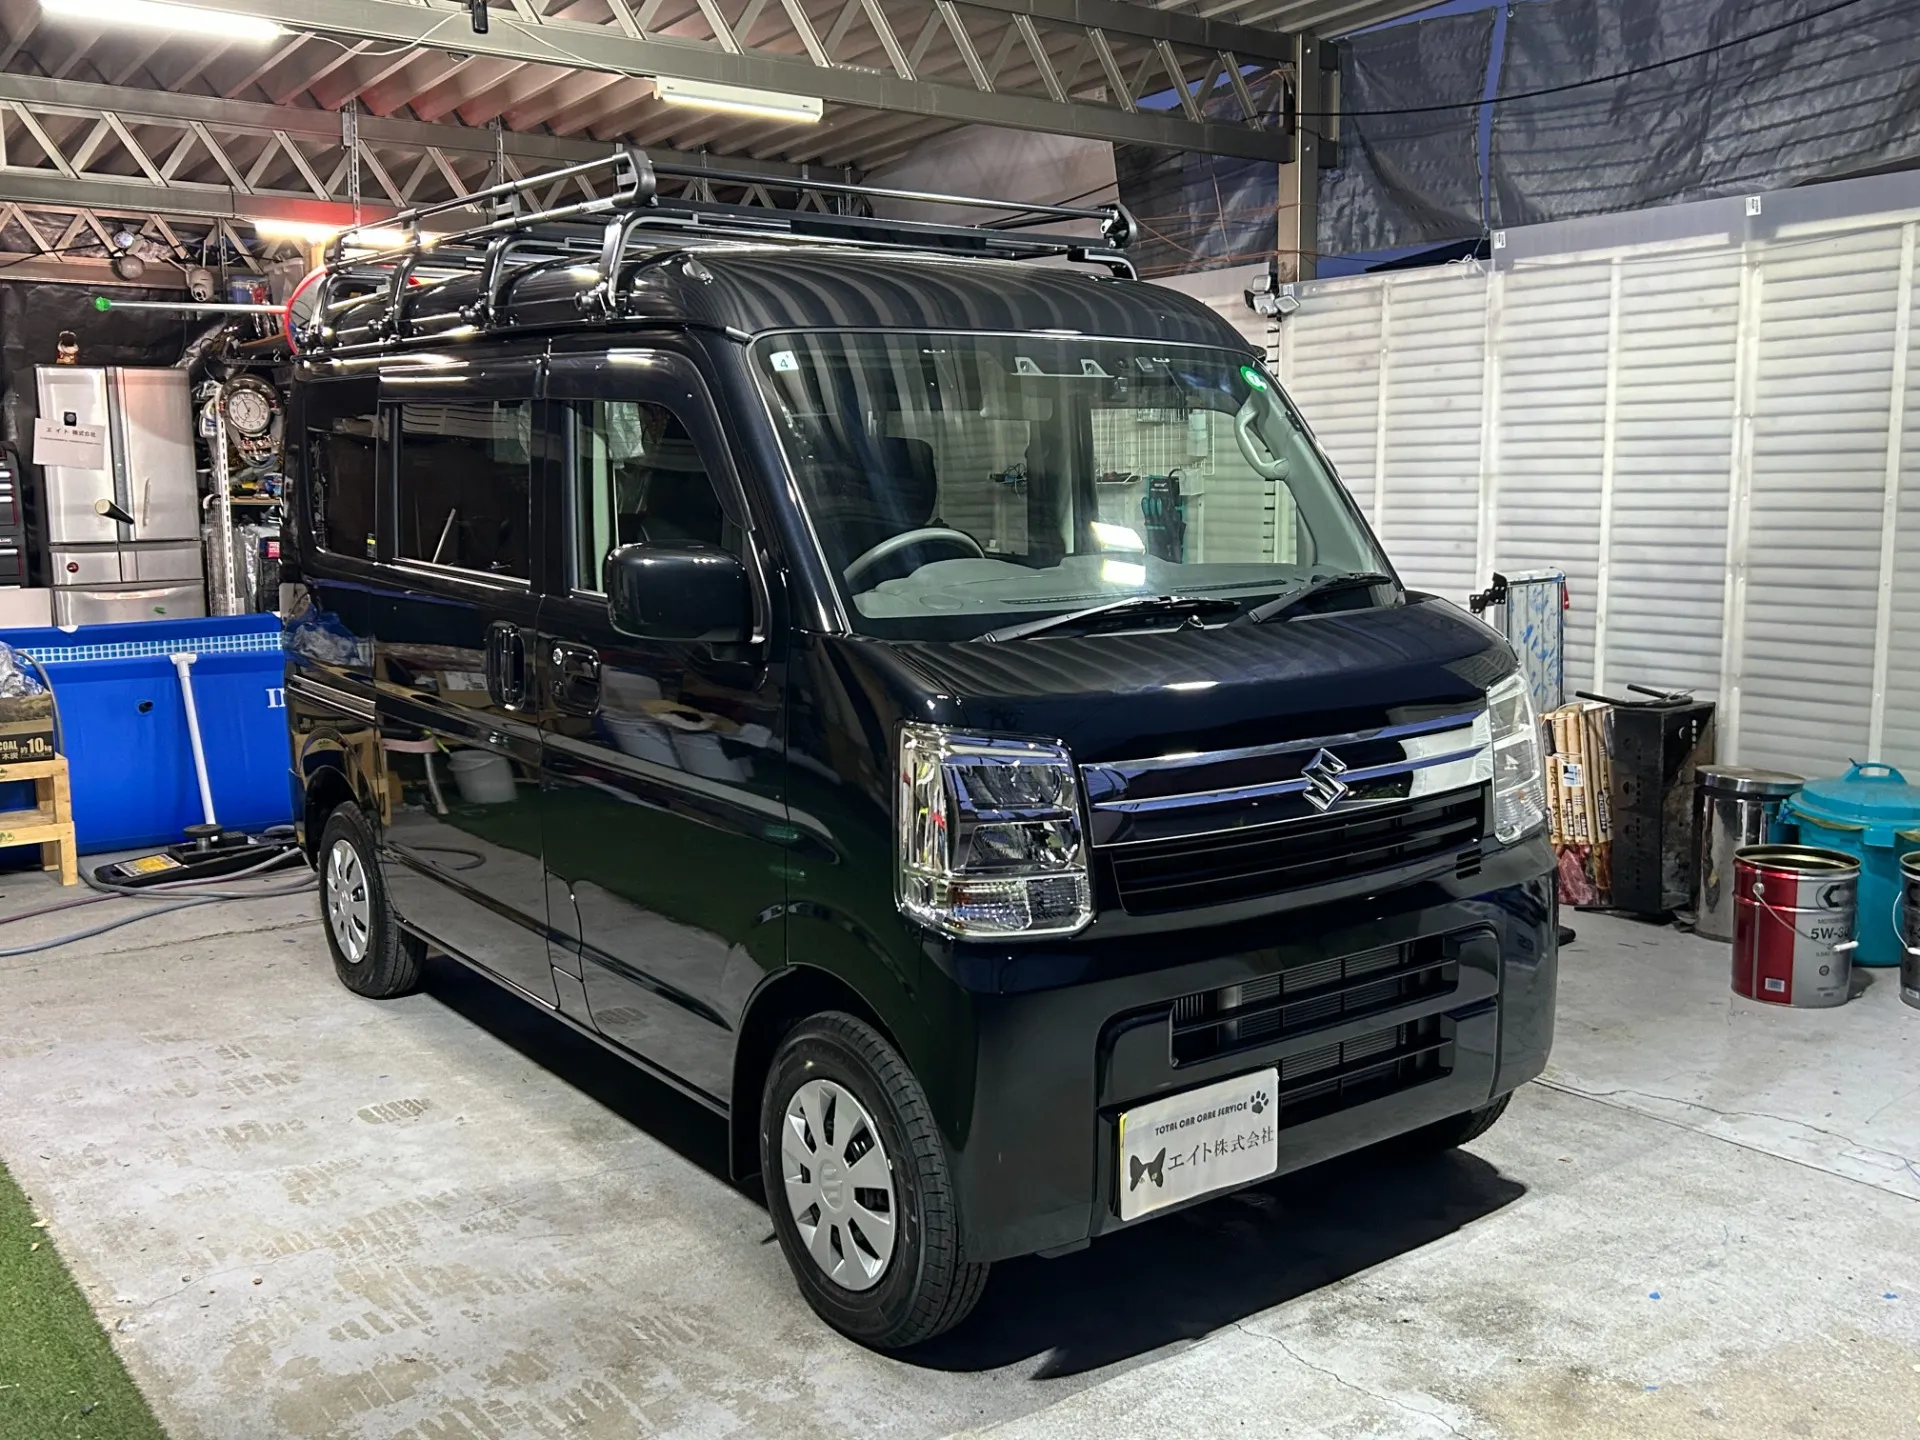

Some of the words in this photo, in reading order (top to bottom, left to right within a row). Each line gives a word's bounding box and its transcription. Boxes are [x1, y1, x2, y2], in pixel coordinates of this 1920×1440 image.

[780, 359, 788, 368] 4
[1155, 1122, 1178, 1136] TOTAL
[1179, 1116, 1195, 1128] CAR
[1196, 1110, 1216, 1123] CARE
[1217, 1101, 1248, 1116] SERVICE
[1168, 1125, 1274, 1171] エイト株式会社
